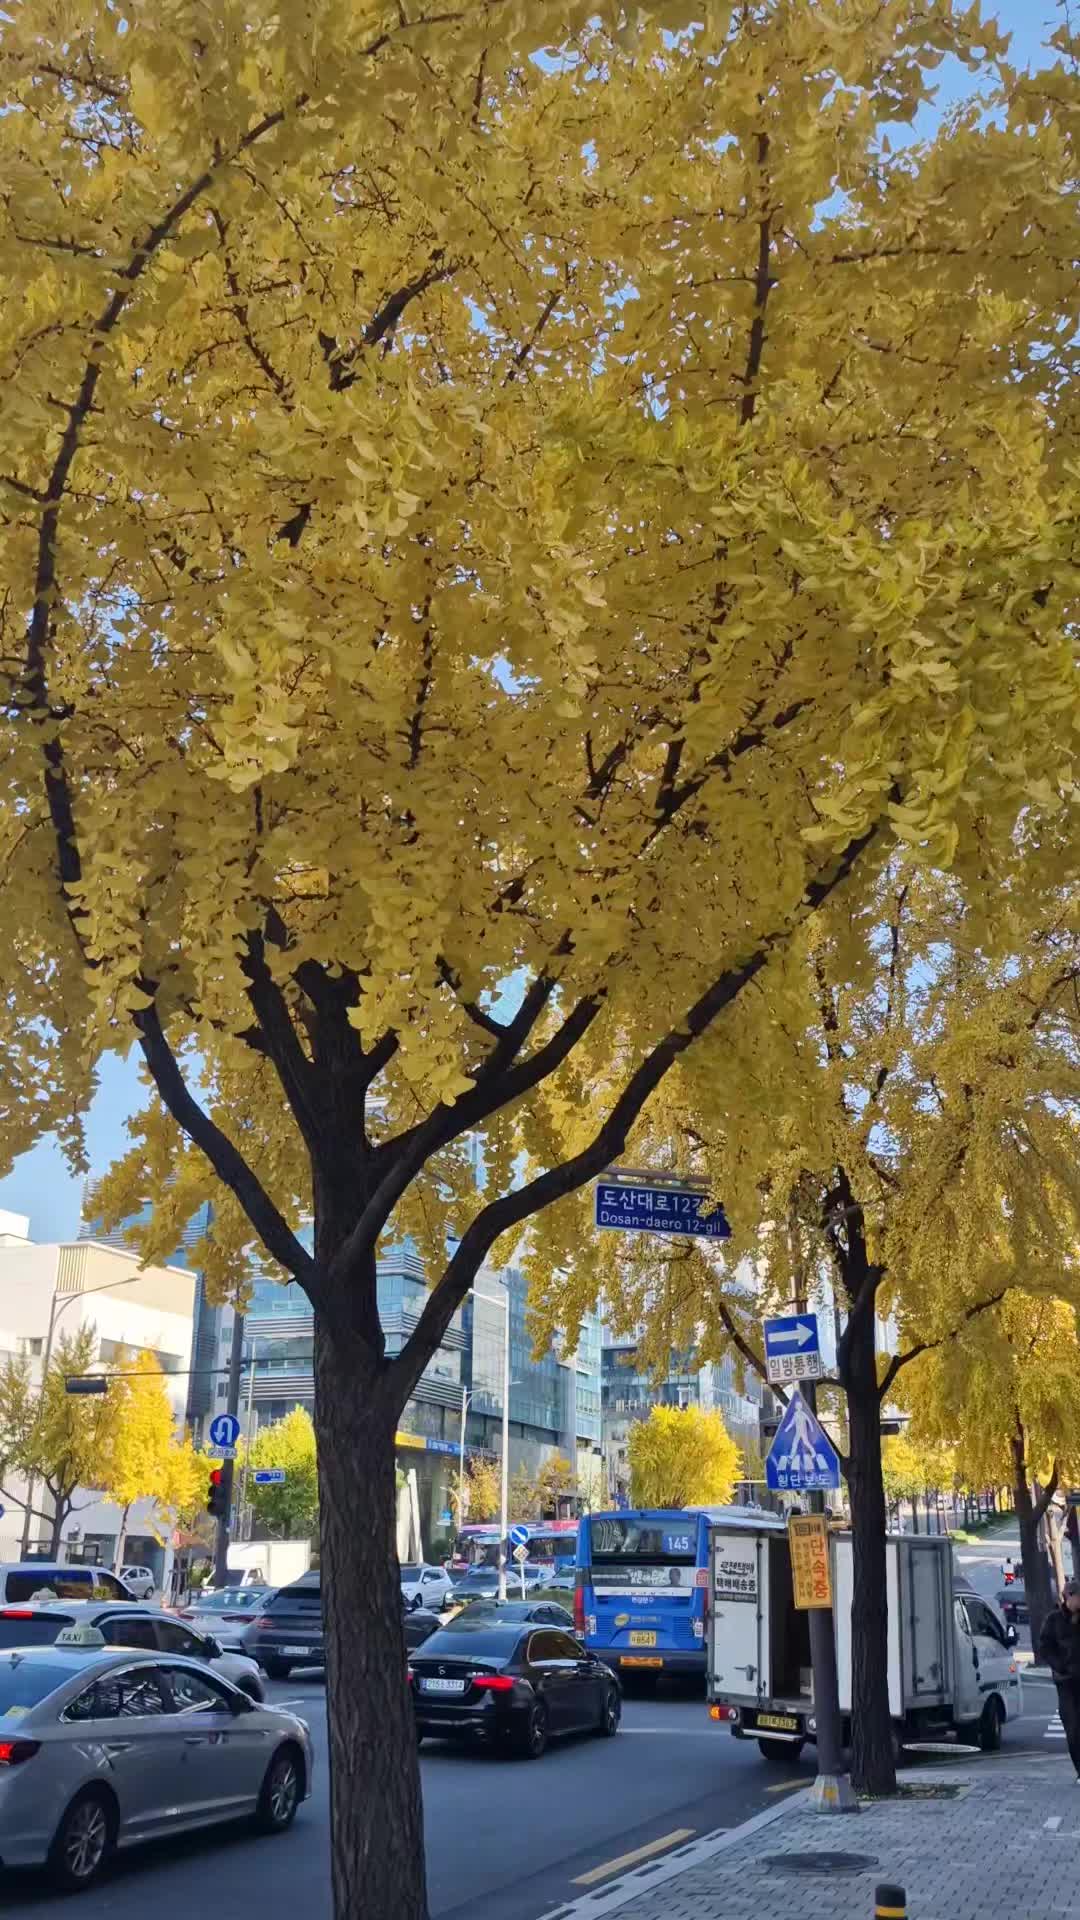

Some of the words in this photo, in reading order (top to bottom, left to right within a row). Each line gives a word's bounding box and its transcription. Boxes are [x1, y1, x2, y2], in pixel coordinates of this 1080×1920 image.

[600, 1210, 682, 1230] Dosan-daero
[687, 1218, 721, 1235] 12-gil
[769, 1353, 819, 1378] 일방통행
[777, 1473, 832, 1488] 횡단보도
[668, 1536, 689, 1551] 145
[62, 1633, 81, 1642] TAXI
